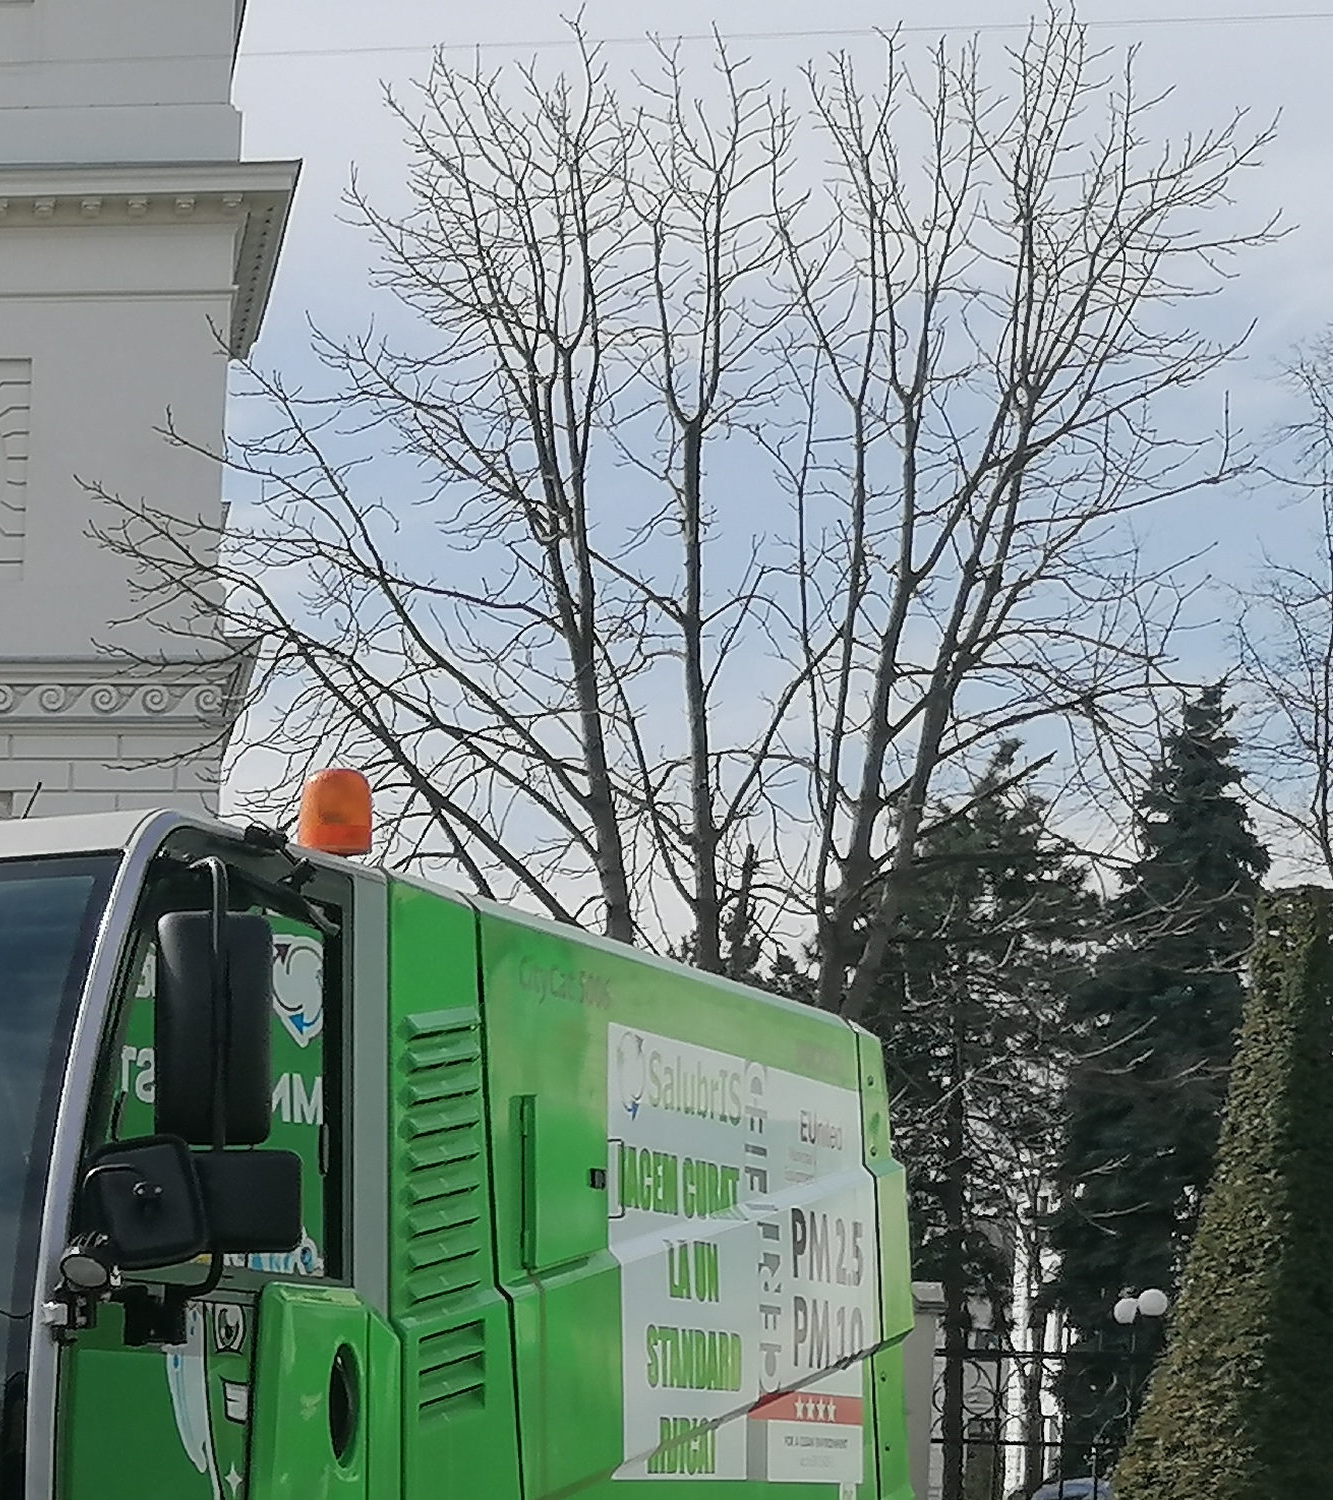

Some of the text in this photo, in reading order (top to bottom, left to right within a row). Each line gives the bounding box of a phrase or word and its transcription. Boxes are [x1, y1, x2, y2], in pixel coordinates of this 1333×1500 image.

[665, 1239, 720, 1303] LA UN
[791, 1207, 864, 1287] PM 2.5
[647, 1323, 743, 1393] STANDARD
[794, 1295, 831, 1369] PM
[647, 1416, 722, 1475] RIDICAT
